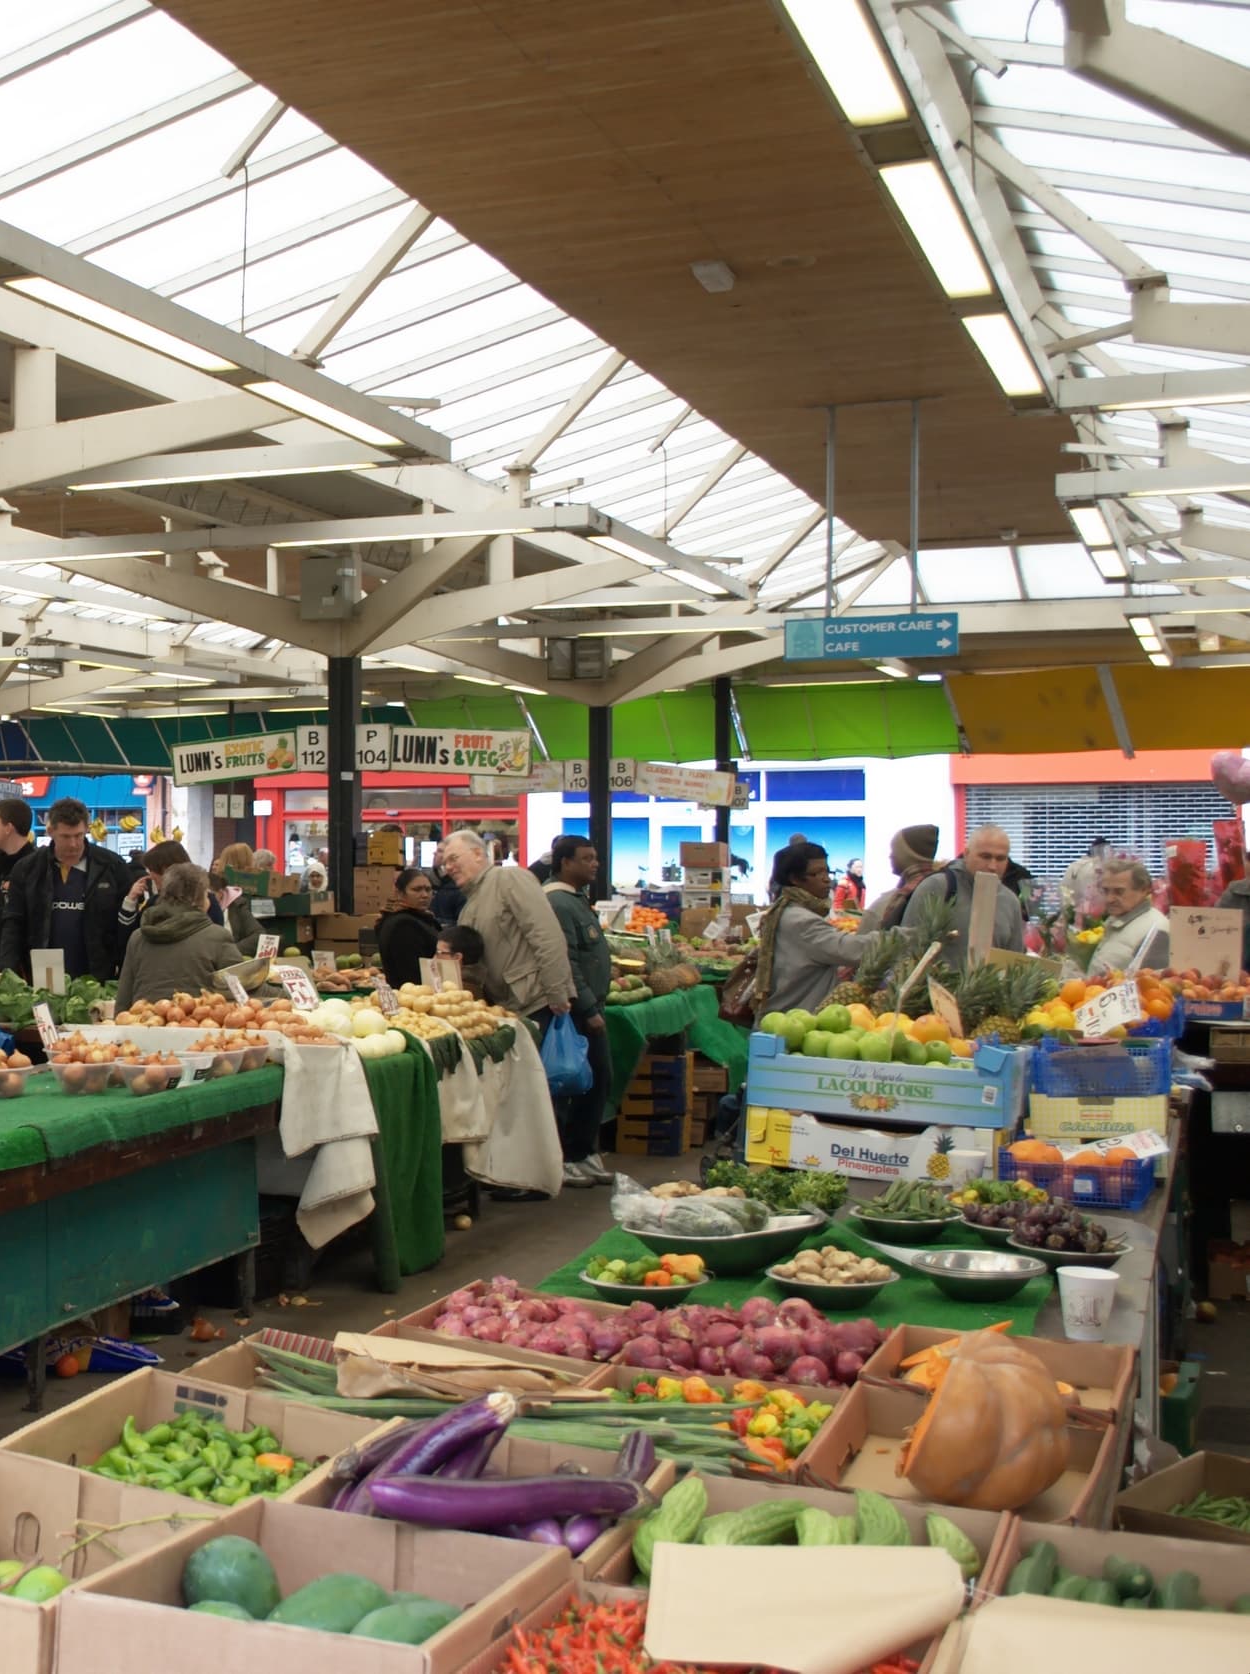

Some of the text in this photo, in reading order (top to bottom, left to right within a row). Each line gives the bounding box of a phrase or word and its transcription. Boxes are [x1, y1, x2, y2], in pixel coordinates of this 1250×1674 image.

[825, 620, 933, 634] CUSTOMER CARE
[14, 647, 29, 657] C5
[825, 641, 860, 653] CAFE
[307, 731, 319, 745] B
[366, 730, 377, 742] P
[454, 734, 493, 749] FRUIT
[224, 740, 264, 755] EXOTIC
[392, 734, 449, 765] LUNN's
[179, 751, 222, 774] LUNN's
[225, 752, 265, 769] FRUITS
[302, 751, 325, 765] 112
[357, 750, 387, 764] 104
[573, 761, 582, 774] B
[617, 762, 626, 773] B
[610, 776, 632, 787] 106
[831, 1143, 909, 1165] Del Huerto
[837, 1158, 900, 1175] Pineapples
